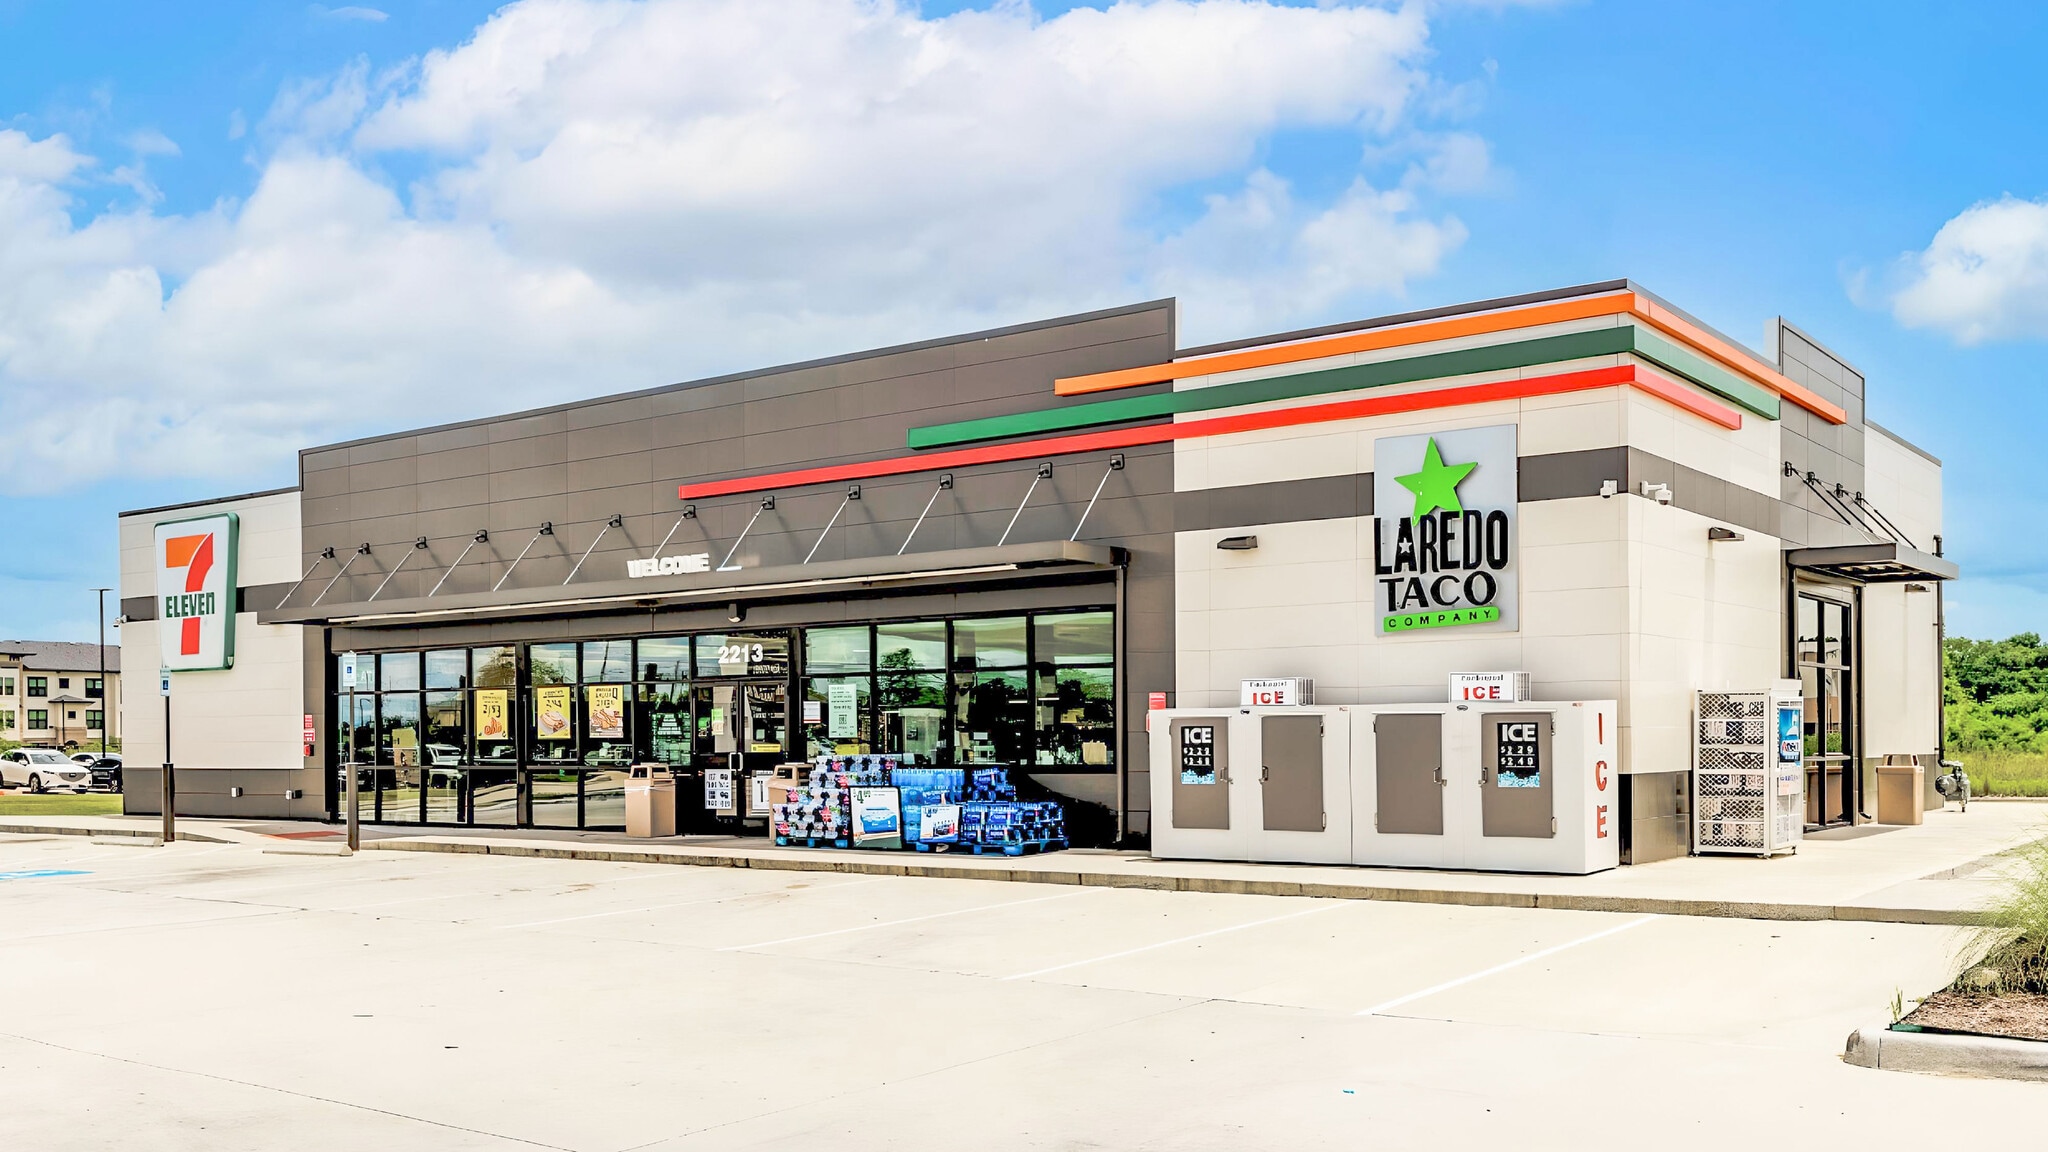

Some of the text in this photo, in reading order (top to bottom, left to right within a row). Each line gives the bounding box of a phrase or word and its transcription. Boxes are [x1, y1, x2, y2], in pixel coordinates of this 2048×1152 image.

[1374, 510, 1509, 575] LAREDO
[626, 552, 711, 579] WELCOME
[166, 532, 214, 655] 7
[1379, 571, 1497, 612] TACO
[717, 643, 764, 664] 2213
[1252, 691, 1284, 705] ICE
[1463, 685, 1501, 701] ICE
[1184, 727, 1212, 745] ICE
[1502, 724, 1536, 742] ICE
[1595, 712, 1608, 839] ICE
